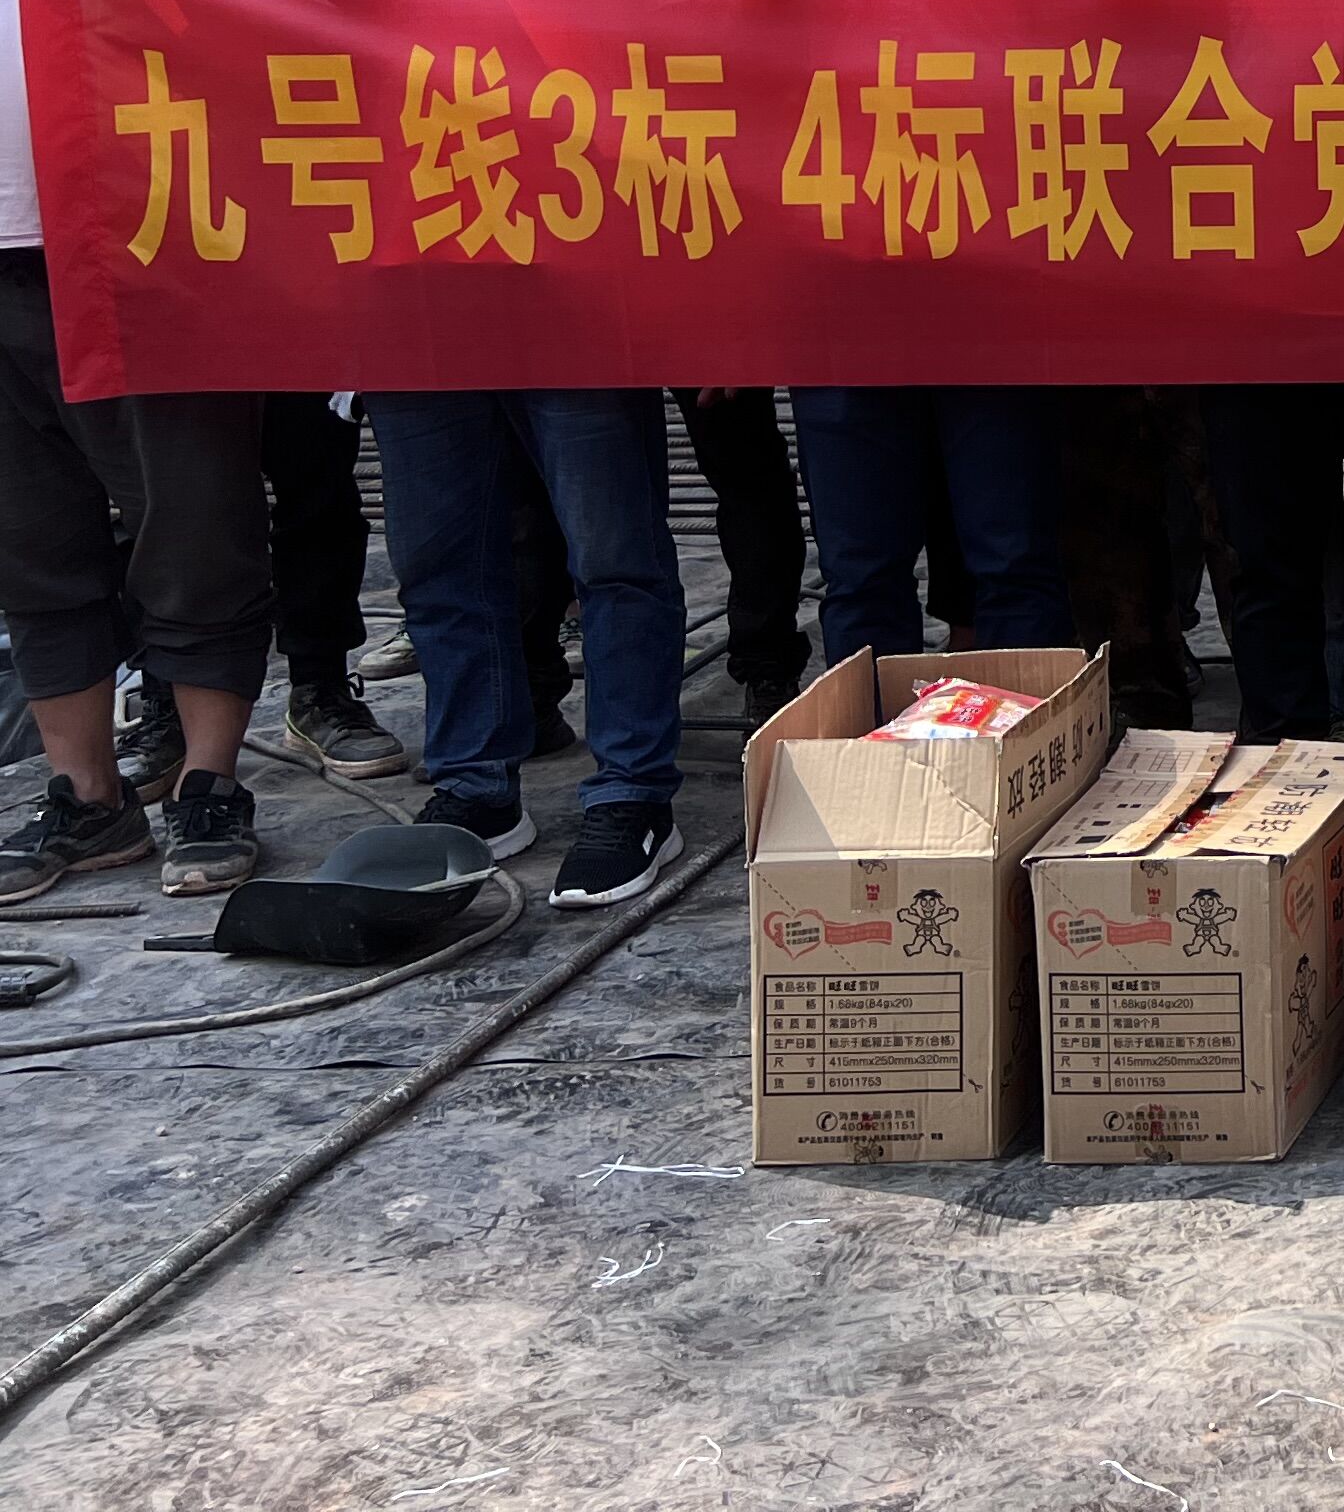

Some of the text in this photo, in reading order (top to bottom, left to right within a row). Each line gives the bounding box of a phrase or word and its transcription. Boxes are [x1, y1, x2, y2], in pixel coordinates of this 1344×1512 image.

[113, 41, 744, 267] 九号线3标
[774, 980, 880, 993] 食品名称 旺旺雪饼
[1059, 979, 1161, 992] 食品名称 旺旺雪饼
[773, 998, 817, 1010] 规格
[1059, 998, 1194, 1010] 规格 1.68kg(84gx20)
[773, 1017, 817, 1030] 保质期
[1059, 1017, 1101, 1029] 保质期
[773, 1037, 817, 1049] 生产日期
[1060, 1037, 1102, 1048] 生产日期
[773, 1056, 816, 1068] 尺寸
[1060, 1055, 1240, 1067] 尺寸 415mmx250mmx320mm
[828, 1076, 882, 1088] 61011753
[1114, 1076, 1166, 1088] 61011753
